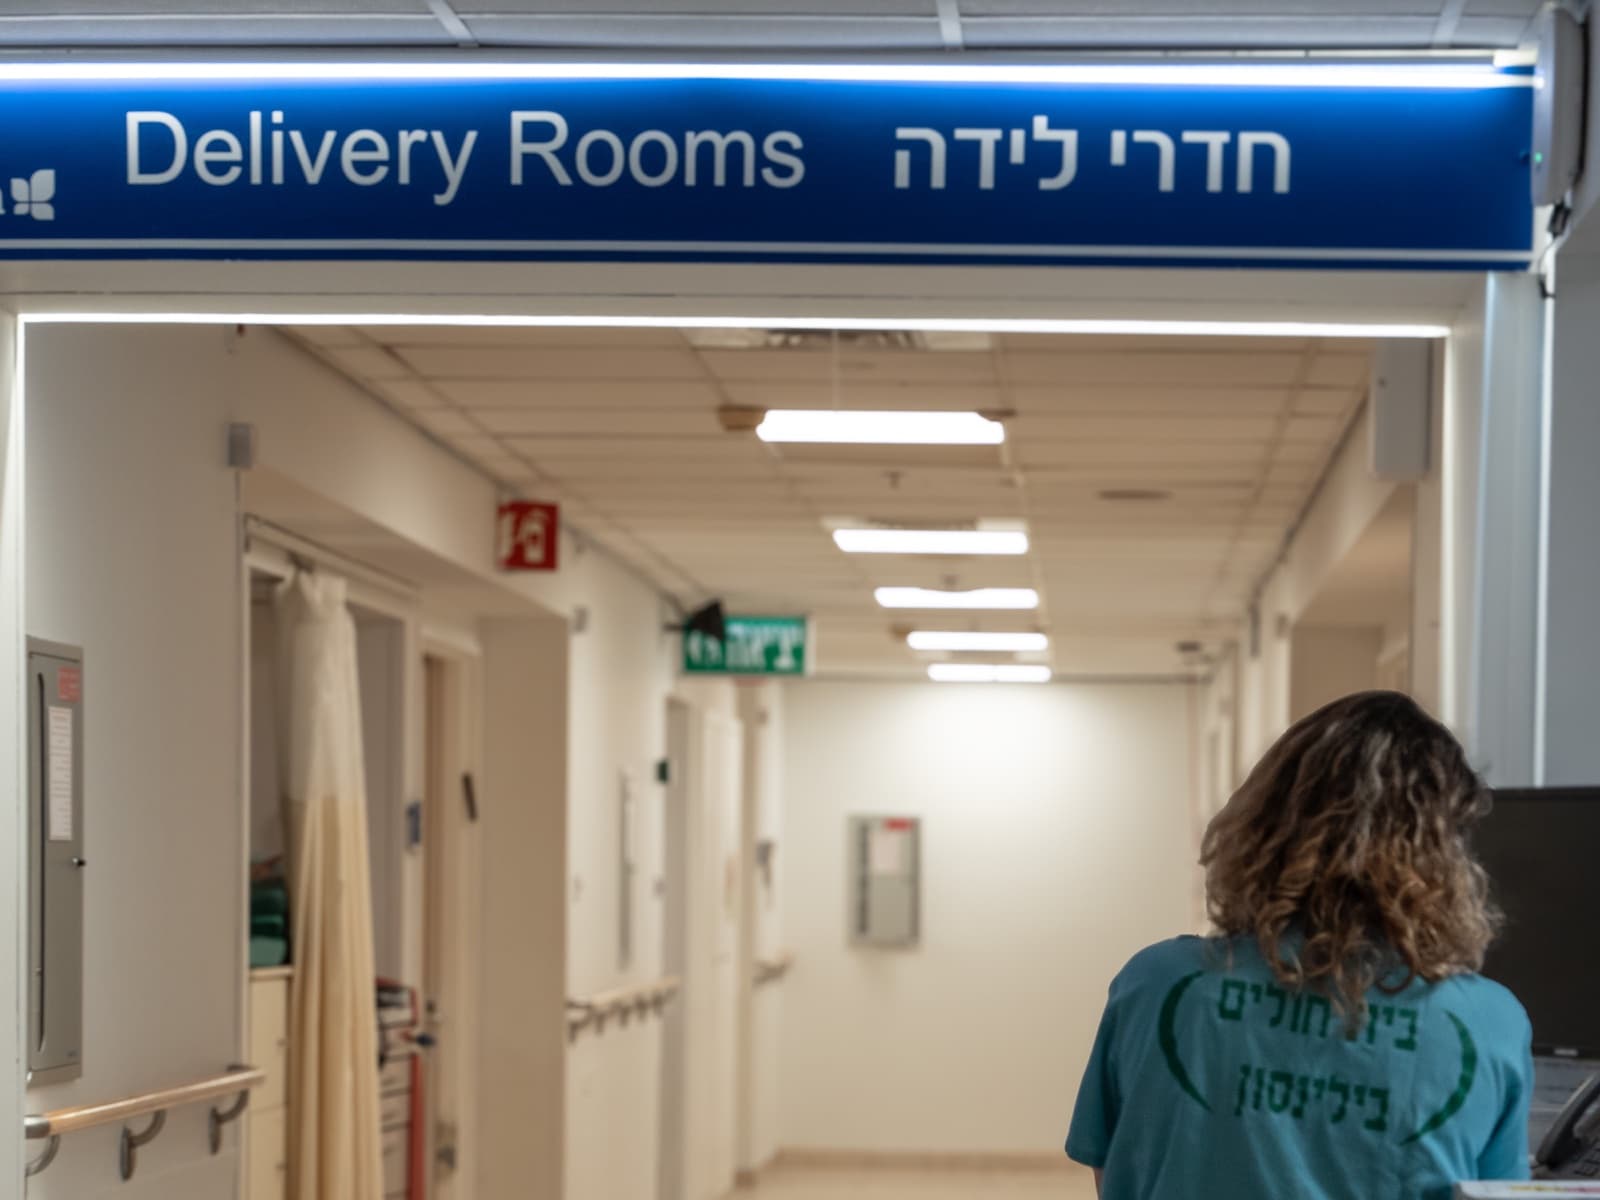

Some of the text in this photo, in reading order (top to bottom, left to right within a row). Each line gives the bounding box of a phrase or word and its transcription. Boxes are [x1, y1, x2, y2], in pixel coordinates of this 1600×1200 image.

[125, 109, 806, 206] Delivery Rooms
[894, 115, 1292, 193] חדרי לידה
[1217, 979, 1331, 1038] חולים
[1234, 1064, 1390, 1132] בילינסון
